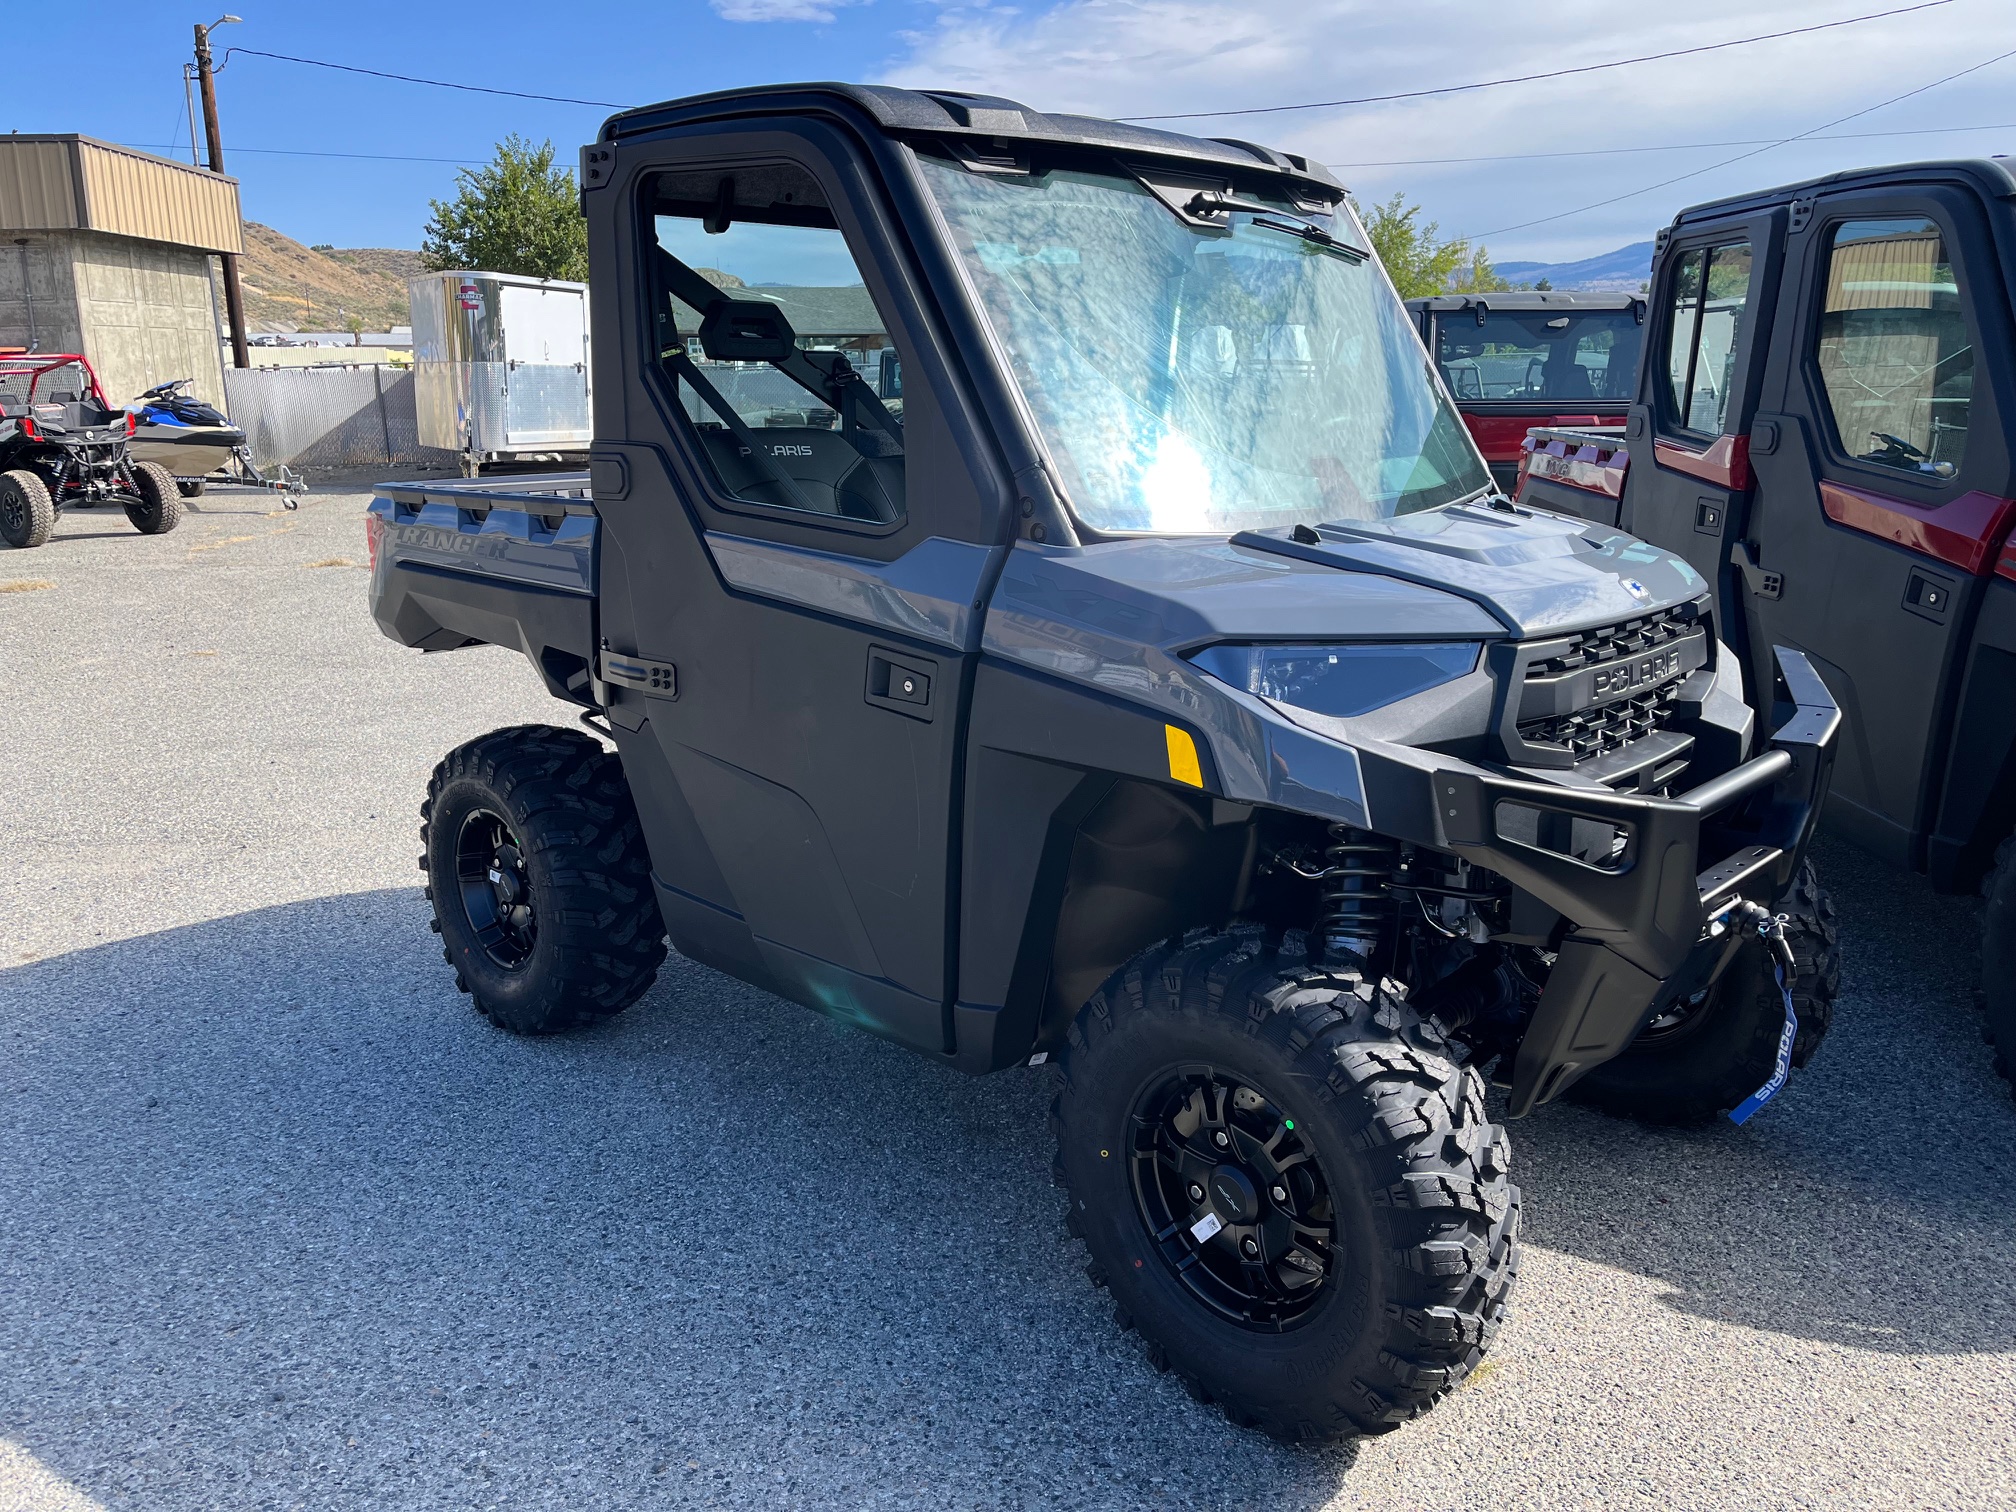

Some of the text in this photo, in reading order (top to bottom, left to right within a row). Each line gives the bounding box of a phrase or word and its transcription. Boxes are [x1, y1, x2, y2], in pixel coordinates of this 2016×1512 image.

[739, 445, 813, 457] PARIS
[401, 526, 510, 561] RANGER
[1592, 648, 1680, 699] POLARIS
[1754, 1020, 1795, 1102] POLARIS
